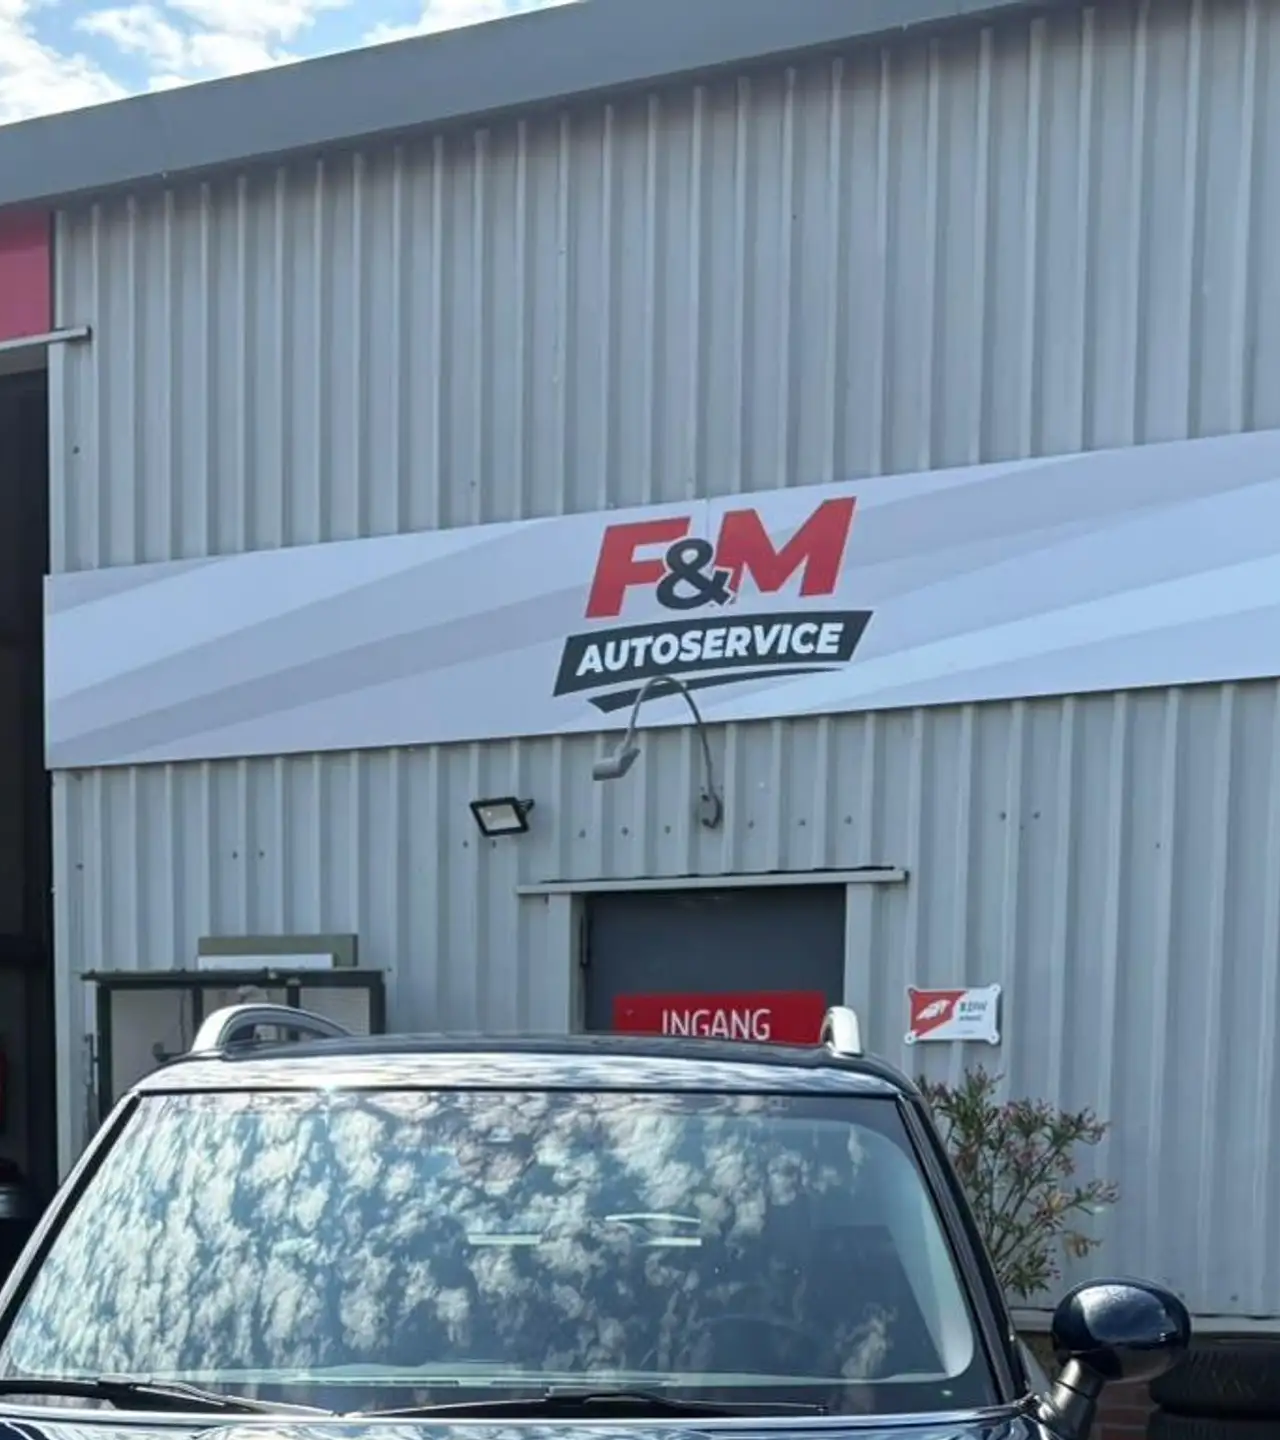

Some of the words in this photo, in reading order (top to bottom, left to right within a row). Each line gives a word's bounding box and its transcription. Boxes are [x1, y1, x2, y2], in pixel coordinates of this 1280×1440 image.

[584, 495, 858, 620] F&M
[575, 620, 845, 677] AUTOSERVICE
[662, 1008, 771, 1041] INGANG
